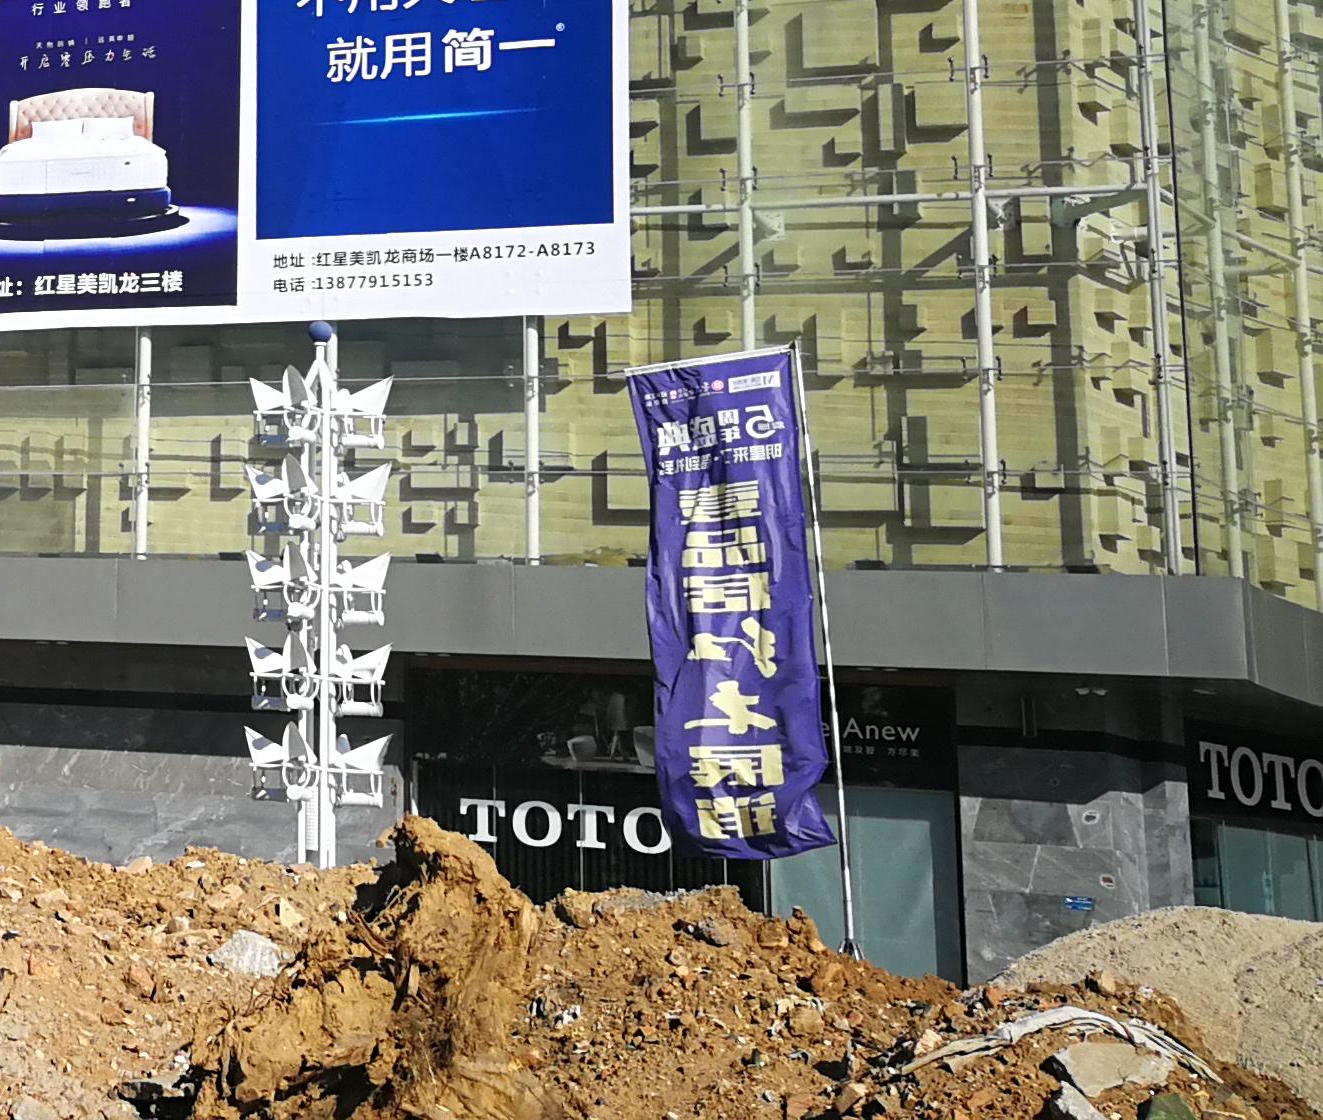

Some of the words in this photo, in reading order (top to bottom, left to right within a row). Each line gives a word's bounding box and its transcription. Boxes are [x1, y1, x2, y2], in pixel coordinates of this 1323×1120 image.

[326, 27, 555, 83] 就用简一
[842, 717, 920, 742] Anew
[1199, 741, 1323, 818] TOTO
[460, 798, 672, 854] TOTO
